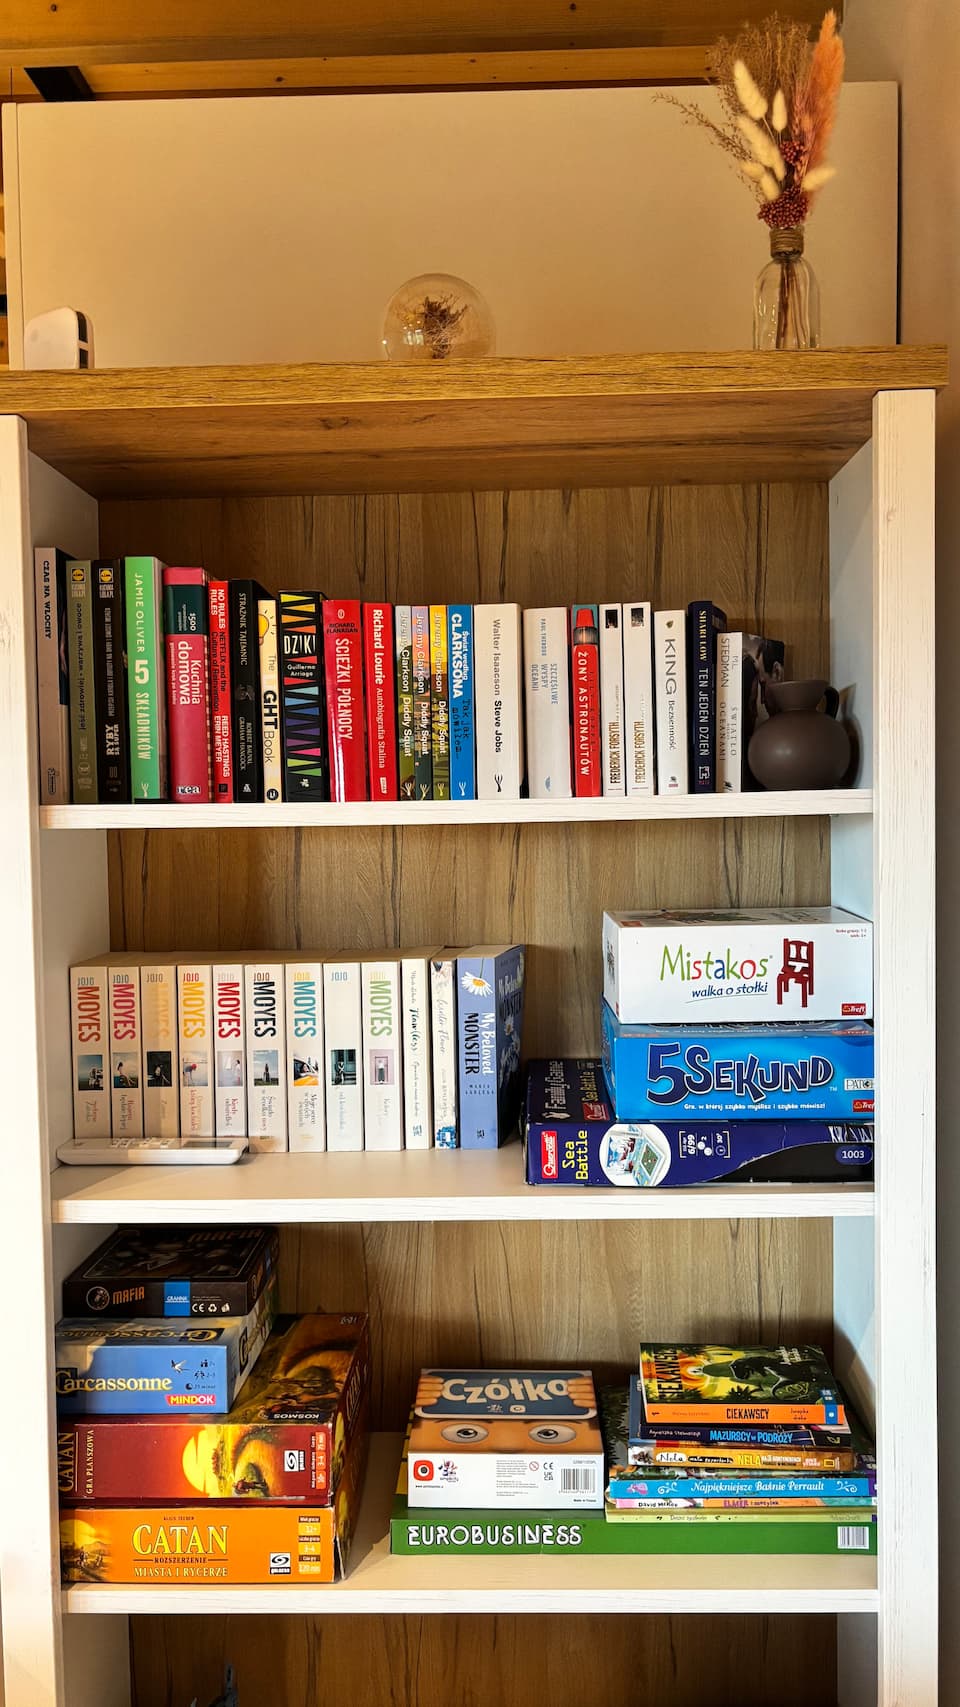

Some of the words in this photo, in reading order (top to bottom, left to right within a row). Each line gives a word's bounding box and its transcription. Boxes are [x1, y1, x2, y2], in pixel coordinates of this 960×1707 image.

[44, 586, 51, 598] NA
[135, 572, 144, 607] JAMIE
[210, 589, 218, 615] RULES
[217, 589, 225, 601] NO
[188, 612, 197, 631] 1500
[218, 603, 226, 629] RULES
[373, 609, 384, 649] Richard
[135, 610, 146, 652] OLIVER
[211, 632, 220, 655] Culture
[284, 635, 316, 654] DZIKI
[415, 614, 424, 649] Jeremy
[462, 631, 470, 652] Świat
[493, 619, 501, 650] Walter
[76, 636, 85, 671] warzywa
[218, 631, 227, 663] NETFLIX
[239, 631, 250, 665] TAJEMNIC
[335, 638, 351, 683] ŚCIEŻKI
[451, 613, 463, 699] CLARKSONA
[699, 641, 707, 661] LOW
[135, 660, 149, 684] 5
[178, 640, 192, 704] domowa
[212, 657, 220, 667] of
[268, 655, 276, 671] The
[375, 653, 385, 684] Lourie
[401, 650, 409, 692] Clarkson
[417, 651, 426, 694] Clarkson
[435, 651, 443, 692] Clarkson
[461, 653, 469, 680] według
[493, 653, 501, 696] Isaacson
[577, 652, 590, 682] ŻONY
[665, 639, 677, 695] KING
[720, 638, 730, 688] STEDMAN
[190, 660, 202, 704] Kuchnia
[212, 669, 220, 712] Reinvention
[531, 664, 539, 691] OCEANII
[550, 664, 559, 704] SZCZĘŚLIWE
[699, 668, 708, 688] TEN
[77, 677, 86, 712] zdrowiej
[263, 676, 278, 729] GHT
[462, 699, 470, 717] Tak
[699, 691, 709, 722] JEDEN
[136, 692, 153, 760] SKŁADNIKÓW
[214, 716, 222, 733] ERIN
[221, 716, 229, 737] REED
[337, 688, 354, 740] PÓŁNOCY
[375, 688, 385, 740] Autobiografia
[402, 698, 411, 727] Diddly
[420, 703, 429, 729] Diddly
[437, 701, 446, 728] Diddly
[493, 700, 502, 727] Steve
[667, 700, 677, 750] Bezsenność
[105, 724, 115, 755] RYBY
[402, 729, 412, 756] Squat
[420, 731, 429, 755] Squat
[438, 730, 446, 753] Squat
[461, 721, 470, 738] jak
[494, 730, 502, 752] Jobs
[579, 688, 592, 776] ASTRONAUTÓW
[608, 722, 620, 749] FORSYTH
[634, 721, 645, 749] FORSYTH
[699, 727, 710, 756] DZIEŃ
[730, 707, 739, 756] ŚWIATŁO
[215, 735, 223, 762] MEYER
[222, 738, 230, 777] HASTINGS
[263, 731, 275, 763] Book
[378, 741, 386, 768] Stalina
[609, 751, 621, 784] FREDERICK
[634, 750, 646, 783] FREDERICK
[176, 786, 200, 794] rea
[254, 972, 270, 981] JOJO
[332, 972, 348, 981] JOJO
[660, 944, 768, 981] Mistakos
[183, 973, 199, 982] JOJO
[692, 984, 723, 998] walka
[726, 987, 733, 995] o
[736, 982, 768, 994] stołki
[77, 986, 101, 1042] MOYES
[112, 983, 136, 1040] MOYES
[182, 982, 205, 1038] MOYES
[217, 982, 240, 1038] MOYES
[253, 982, 276, 1037] MOYES
[293, 981, 316, 1037] MOYES
[370, 980, 392, 1036] MOYES
[481, 1013, 496, 1028] My
[850, 1005, 865, 1013] Trefl
[464, 1013, 480, 1074] MONSTER
[481, 1031, 496, 1074] Beloved
[580, 1071, 597, 1091] Battle
[647, 1042, 689, 1105] 5
[582, 1091, 599, 1101] Sea
[562, 1141, 575, 1169] Sea
[576, 1130, 588, 1179] Battle
[842, 1150, 865, 1159] 1003
[112, 1286, 145, 1305] MAFIA
[170, 1395, 215, 1404] MINDOK
[441, 1378, 569, 1404] Czółko
[726, 1408, 770, 1420] CIEKAWSCY
[710, 1430, 751, 1442] MAZURSCY
[757, 1431, 793, 1443] PODRÓŻY
[59, 1432, 74, 1492] CATAN
[86, 1430, 94, 1476] PLANSZOWA
[660, 1453, 684, 1462] Nela
[738, 1455, 762, 1465] NELA
[691, 1481, 752, 1494] Najpiękniejsze
[755, 1481, 786, 1492] Baśnie
[788, 1481, 824, 1491] Perrault
[132, 1525, 228, 1555] CATAN
[407, 1525, 582, 1546] EUROBUSINESS
[134, 1567, 173, 1577] MIASTA
[176, 1567, 179, 1577] I
[183, 1567, 228, 1577] RYCERZE
